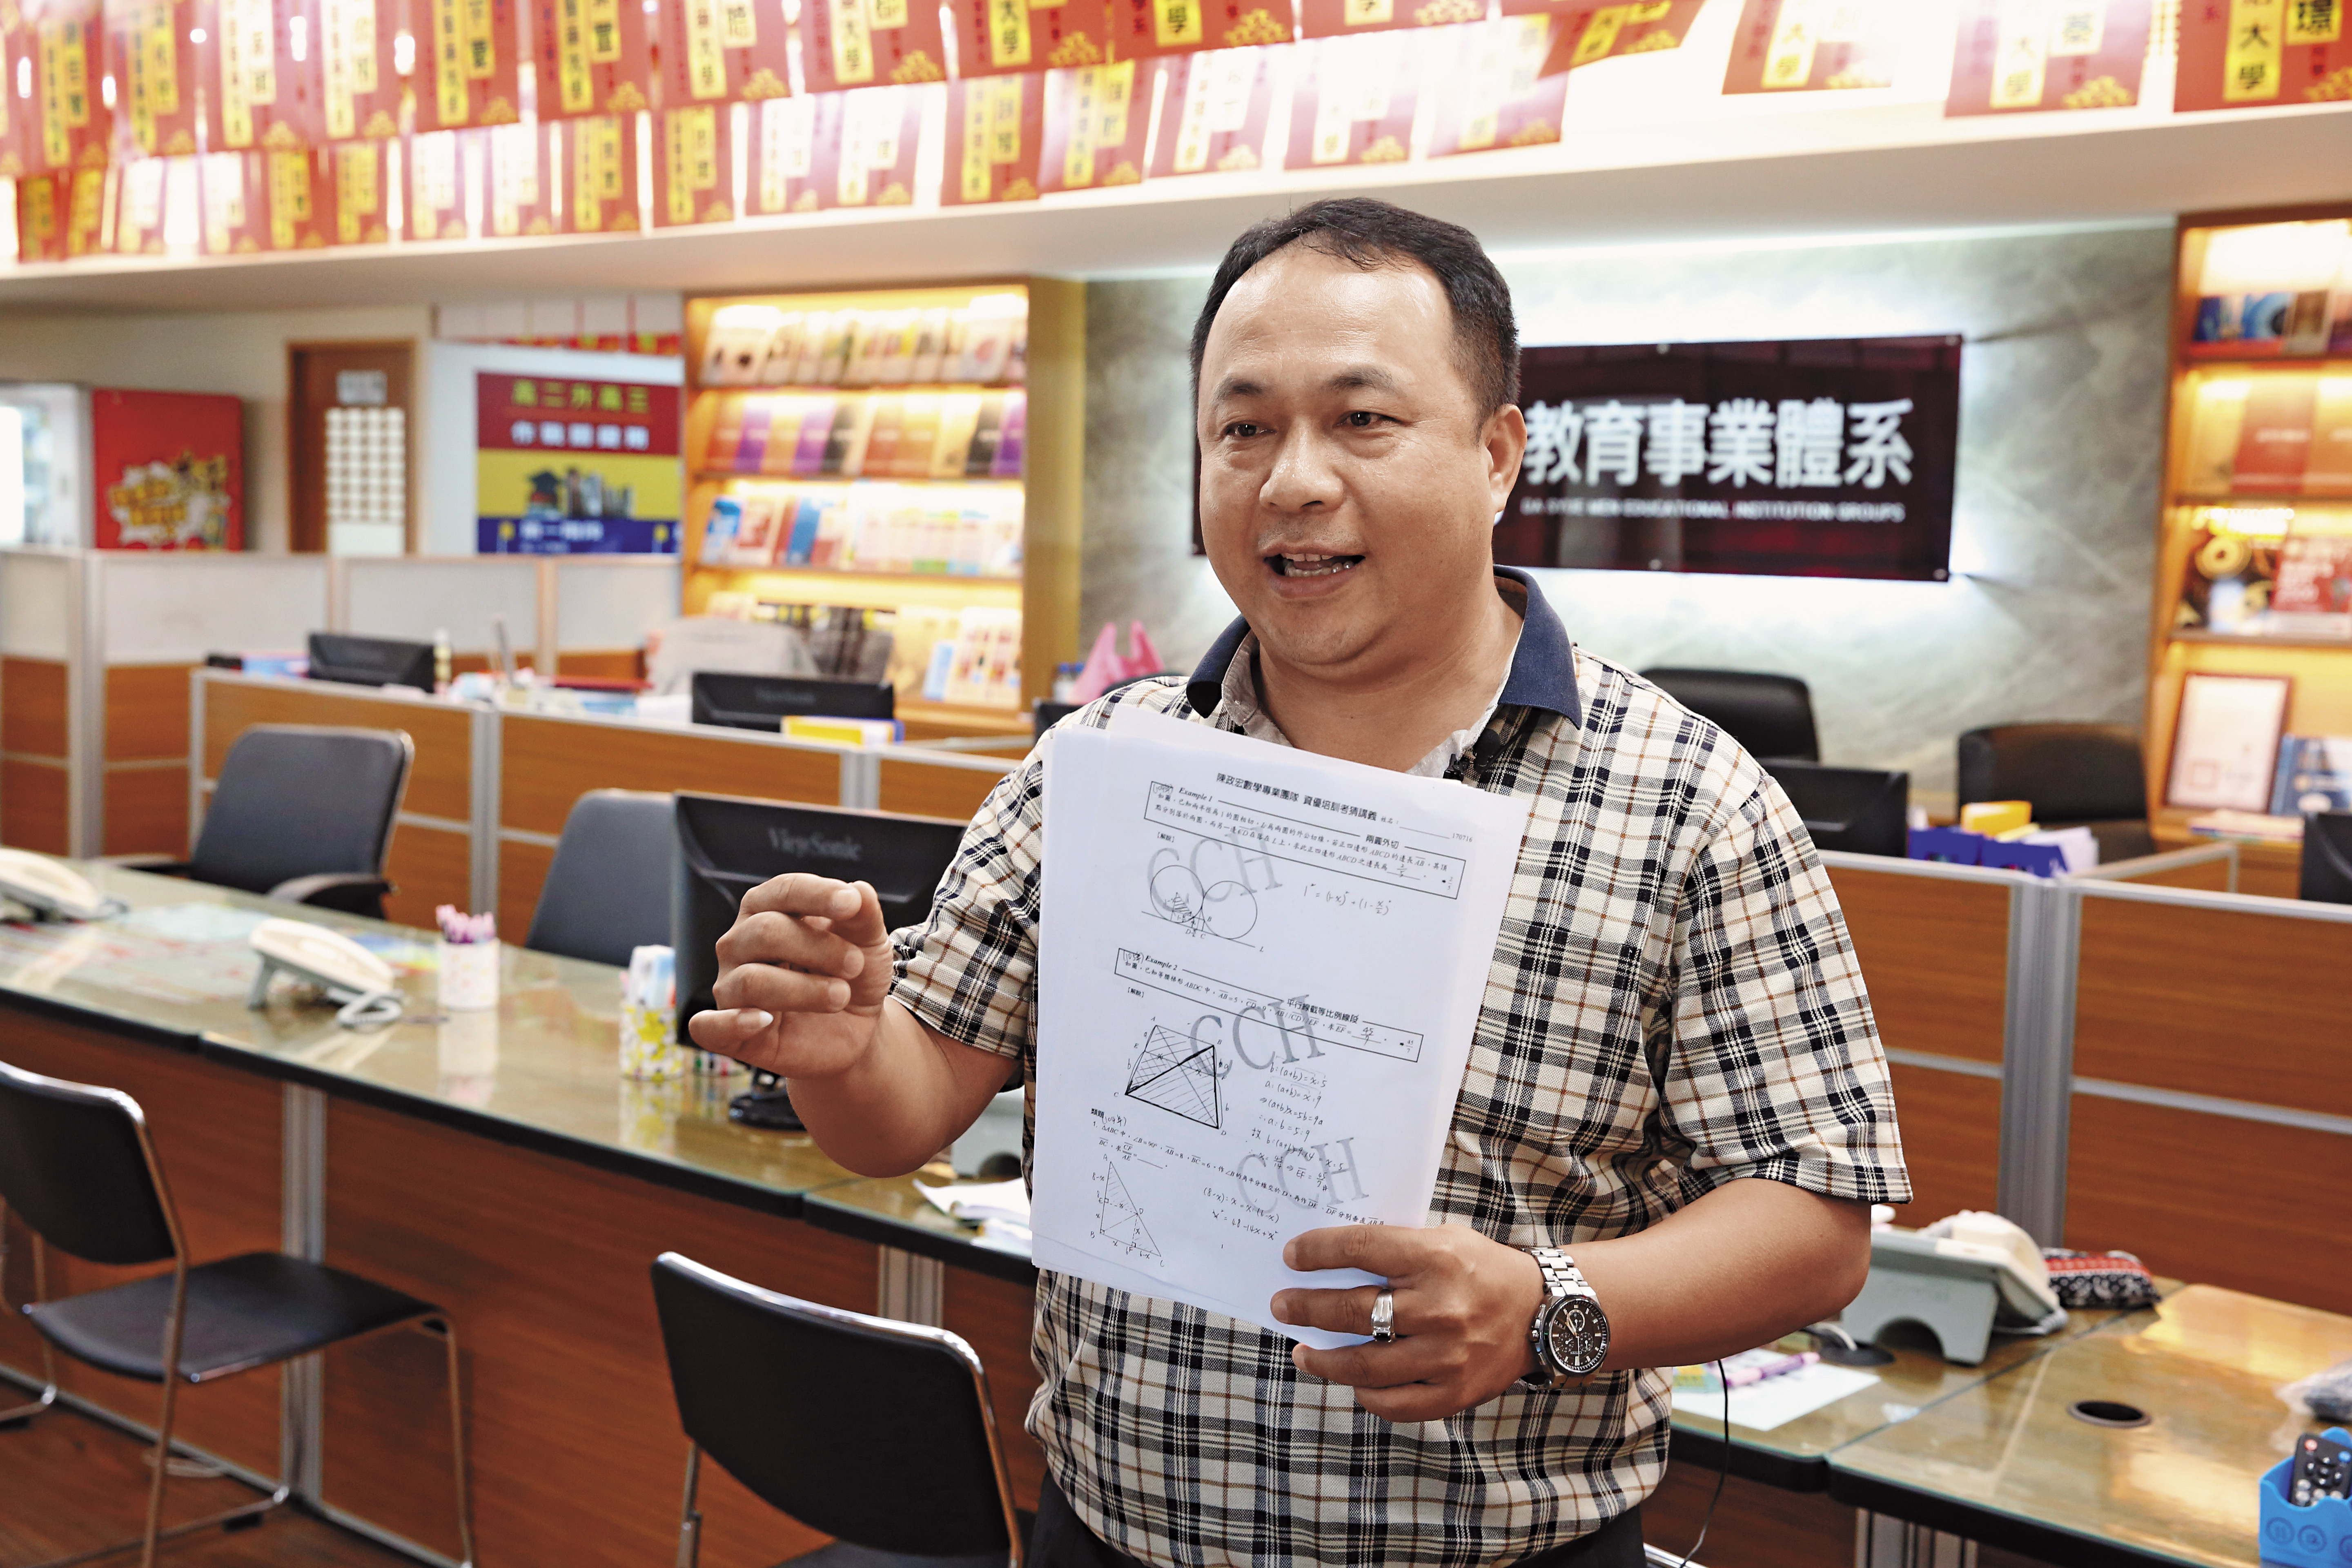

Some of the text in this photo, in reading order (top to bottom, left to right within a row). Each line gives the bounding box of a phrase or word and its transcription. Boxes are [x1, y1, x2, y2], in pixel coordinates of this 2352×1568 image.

[1522, 396, 1914, 488] 教育事業體系
[1622, 499, 1729, 519] EDUCATIONAL
[1732, 500, 1835, 521] INSTITUTION
[1837, 501, 1906, 523] GROUPS
[1179, 788, 1207, 800] Example
[1217, 773, 1299, 802] 陳政宏數學專業團隊
[1452, 833, 1472, 842] 170716
[1147, 825, 1282, 912] CCH
[1145, 956, 1172, 969] Example
[1191, 995, 1325, 1077] CCH
[1236, 1137, 1369, 1213] CCH
